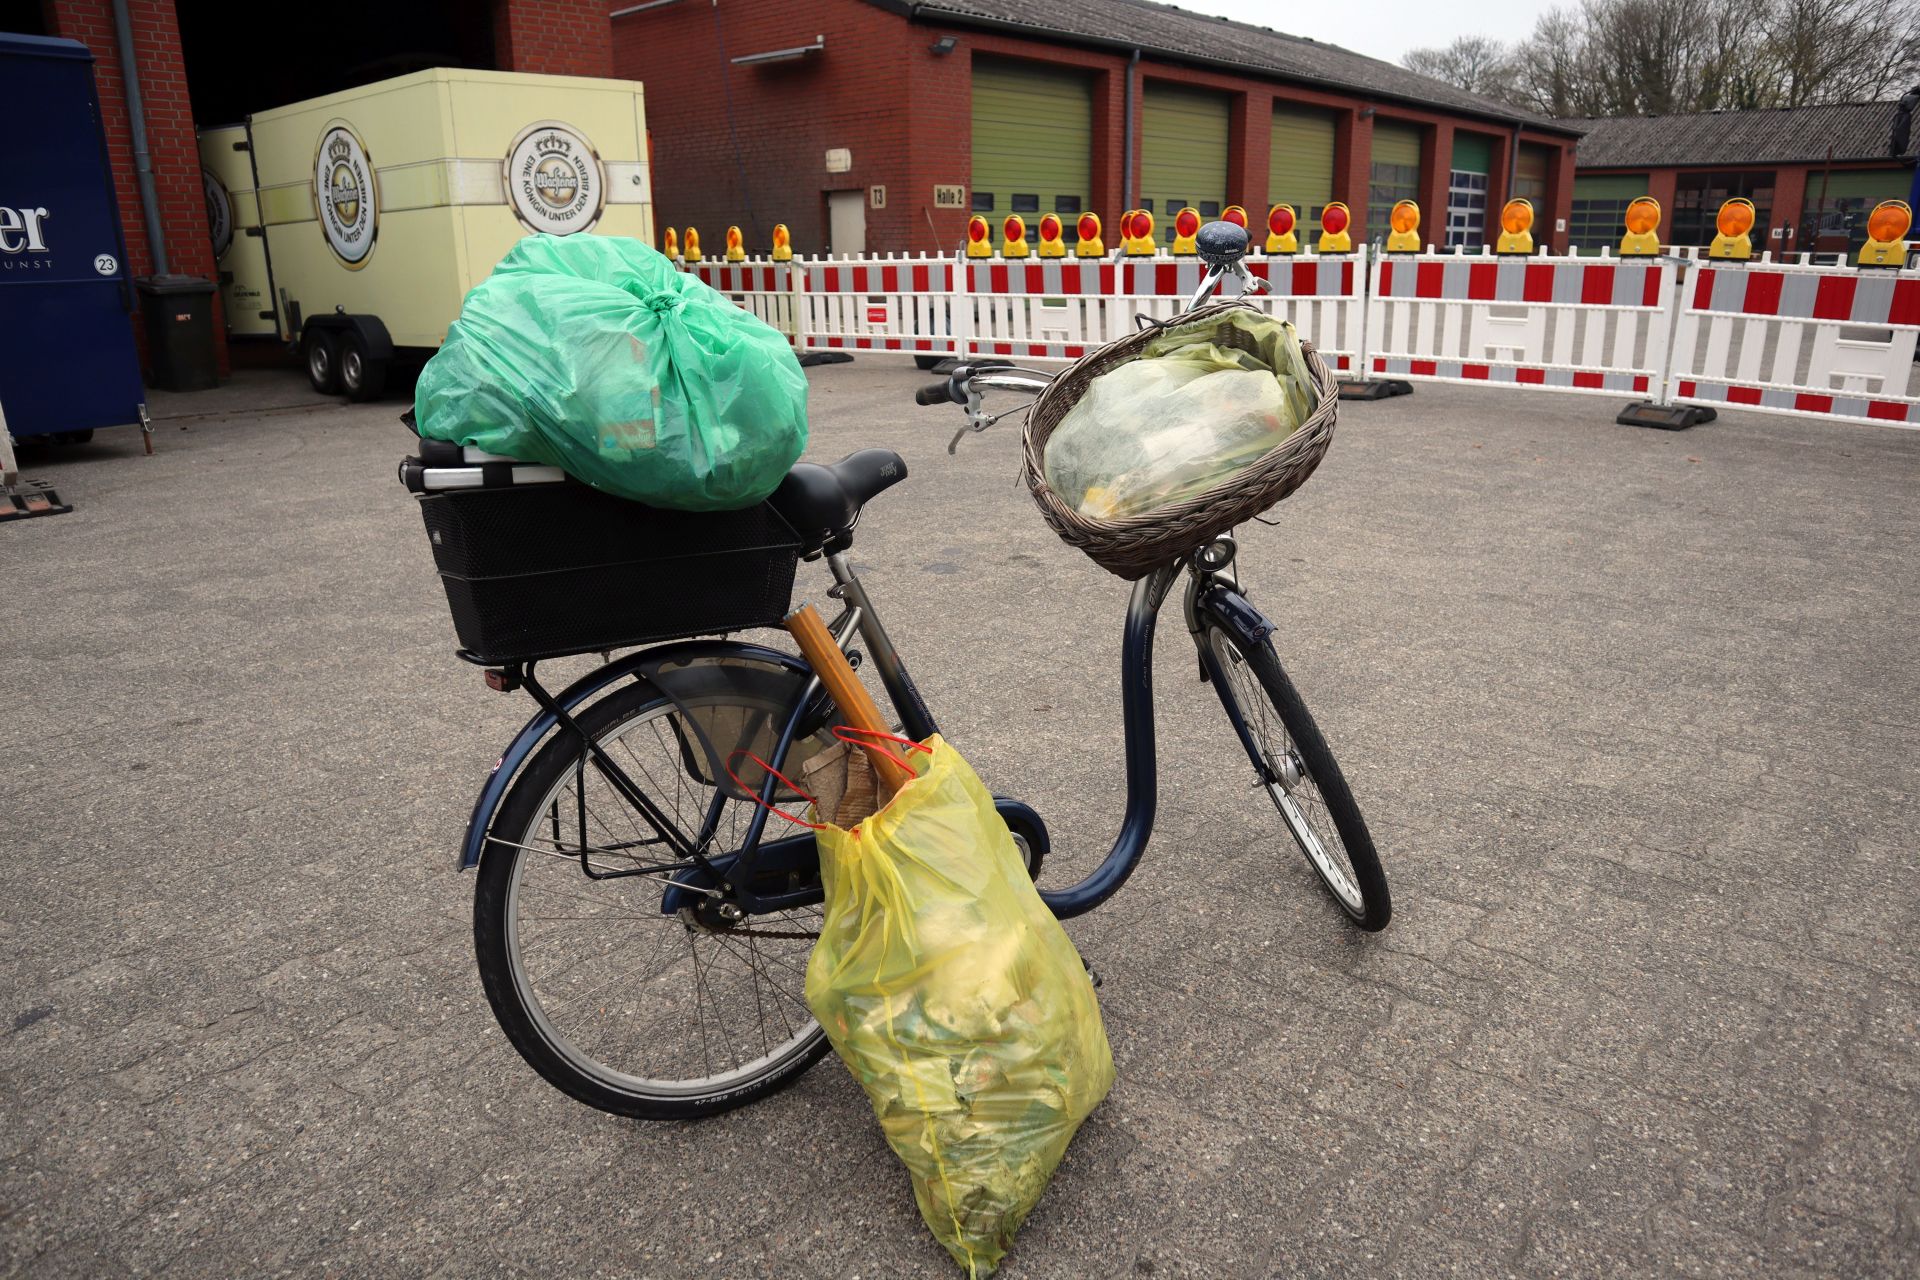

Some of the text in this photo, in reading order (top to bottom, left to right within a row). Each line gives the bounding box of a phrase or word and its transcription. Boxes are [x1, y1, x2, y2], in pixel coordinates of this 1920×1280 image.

[523, 155, 589, 222] EINE KÖNIGIN UNTER DEN BIEREN
[936, 188, 963, 204] Halle 2
[98, 259, 114, 271] 23
